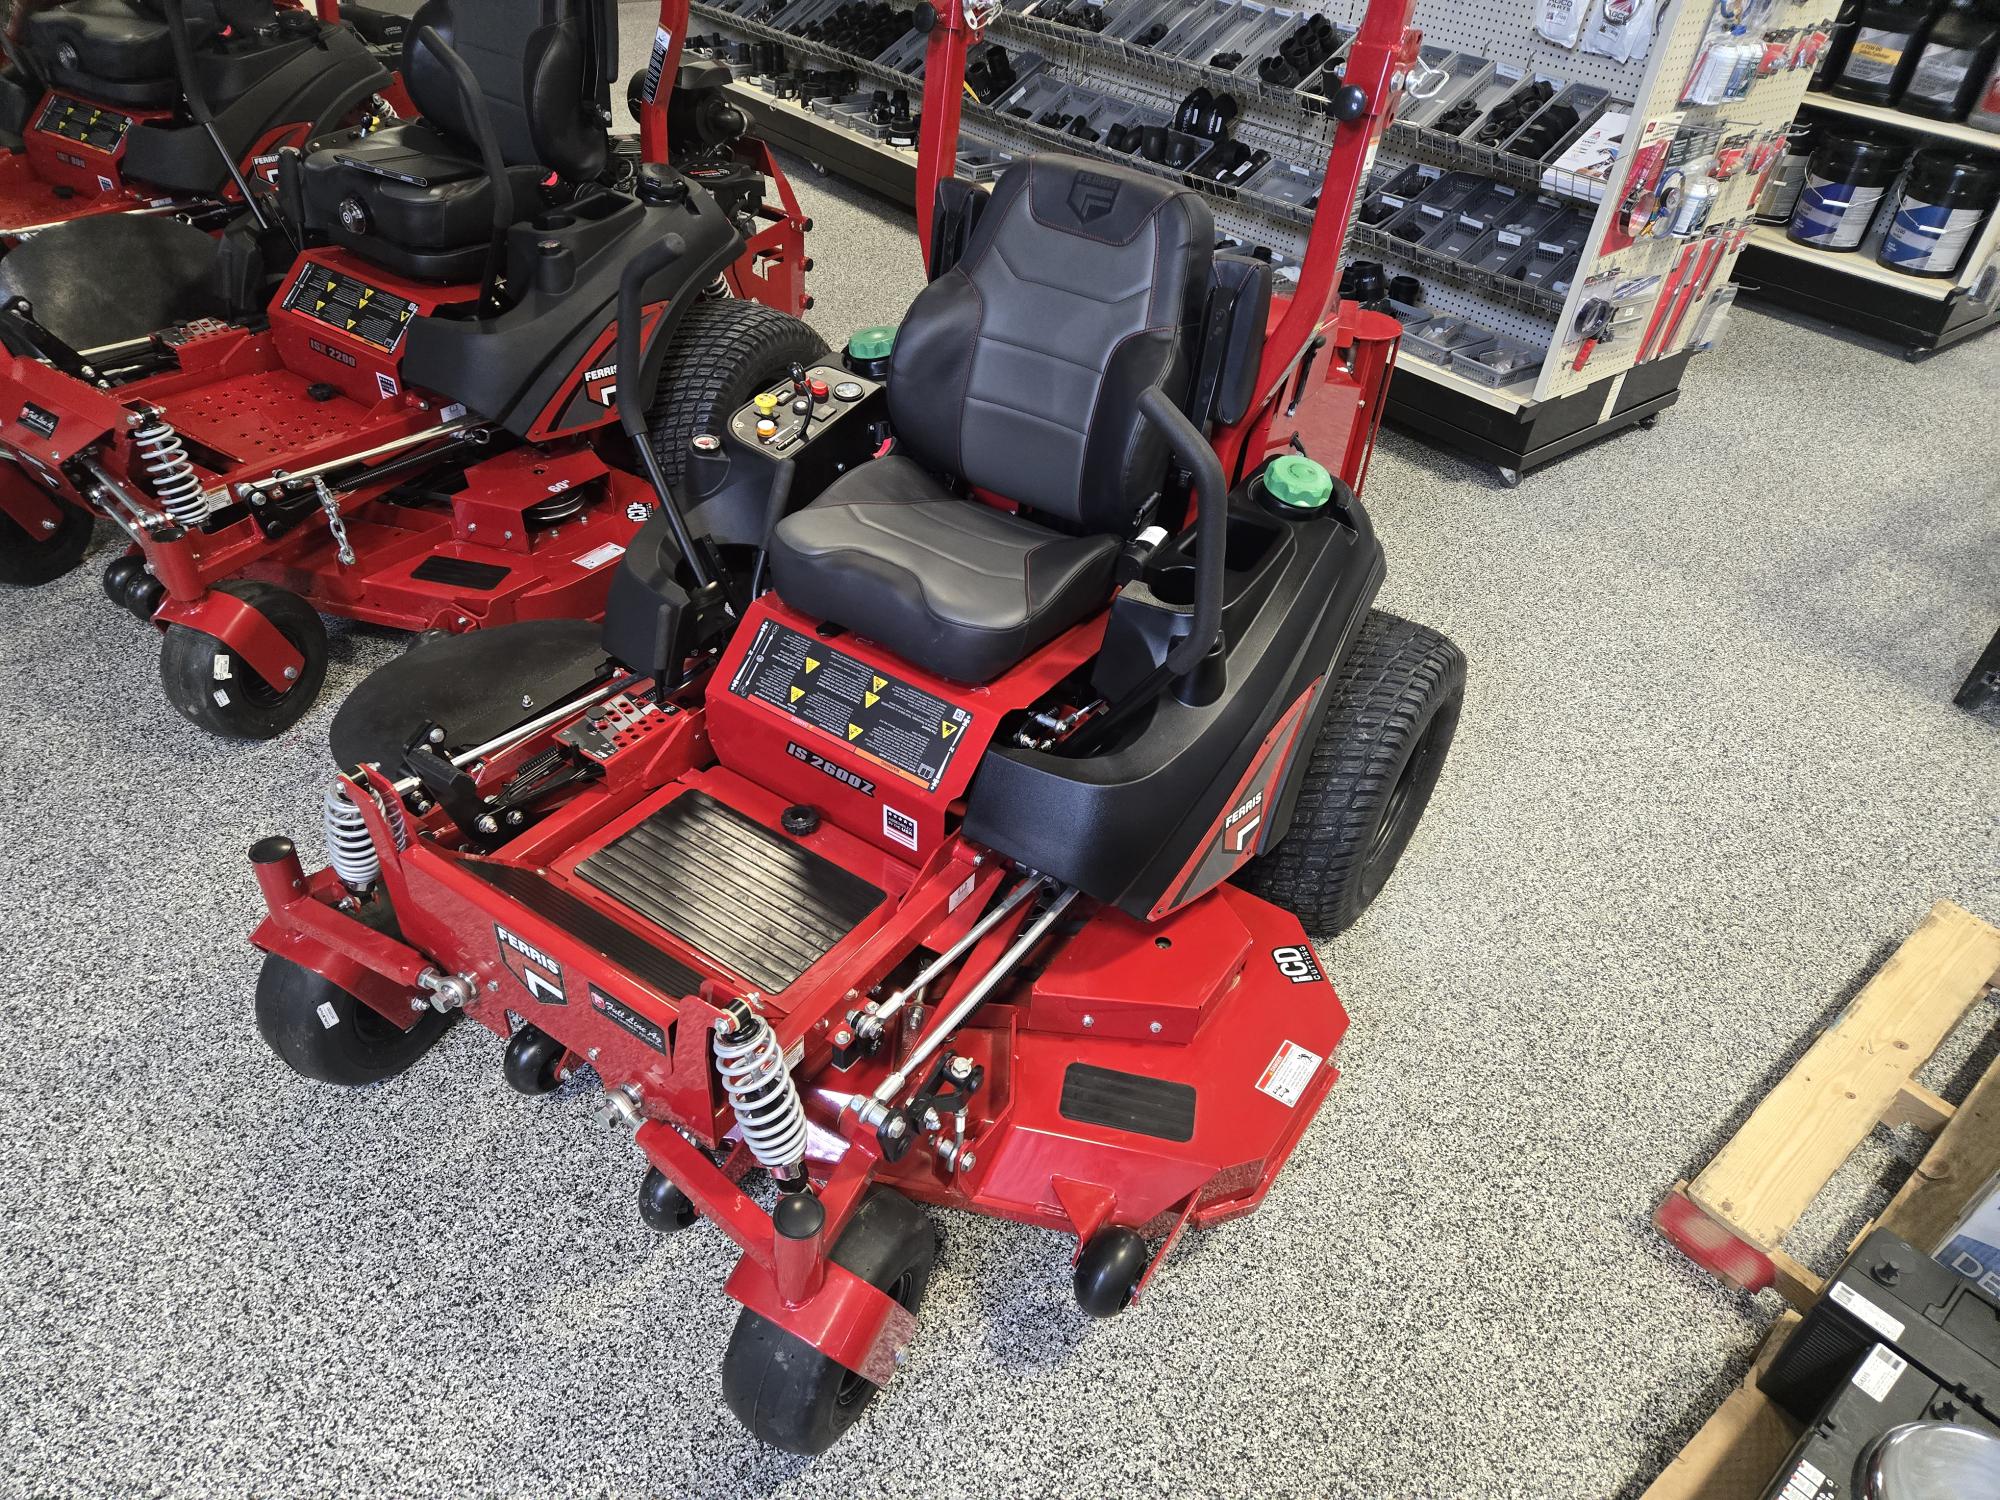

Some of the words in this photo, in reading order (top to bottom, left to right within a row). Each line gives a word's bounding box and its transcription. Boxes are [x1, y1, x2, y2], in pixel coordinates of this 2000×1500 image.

[788, 743, 808, 760] IS
[810, 755, 874, 796] 2600Z
[1226, 792, 1262, 828] FERRIS
[497, 927, 560, 974] FERRIS
[1299, 946, 1321, 980] CUTTING
[605, 1001, 625, 1018] Full
[626, 1016, 647, 1033] Line
[647, 1031, 662, 1044] Ag
